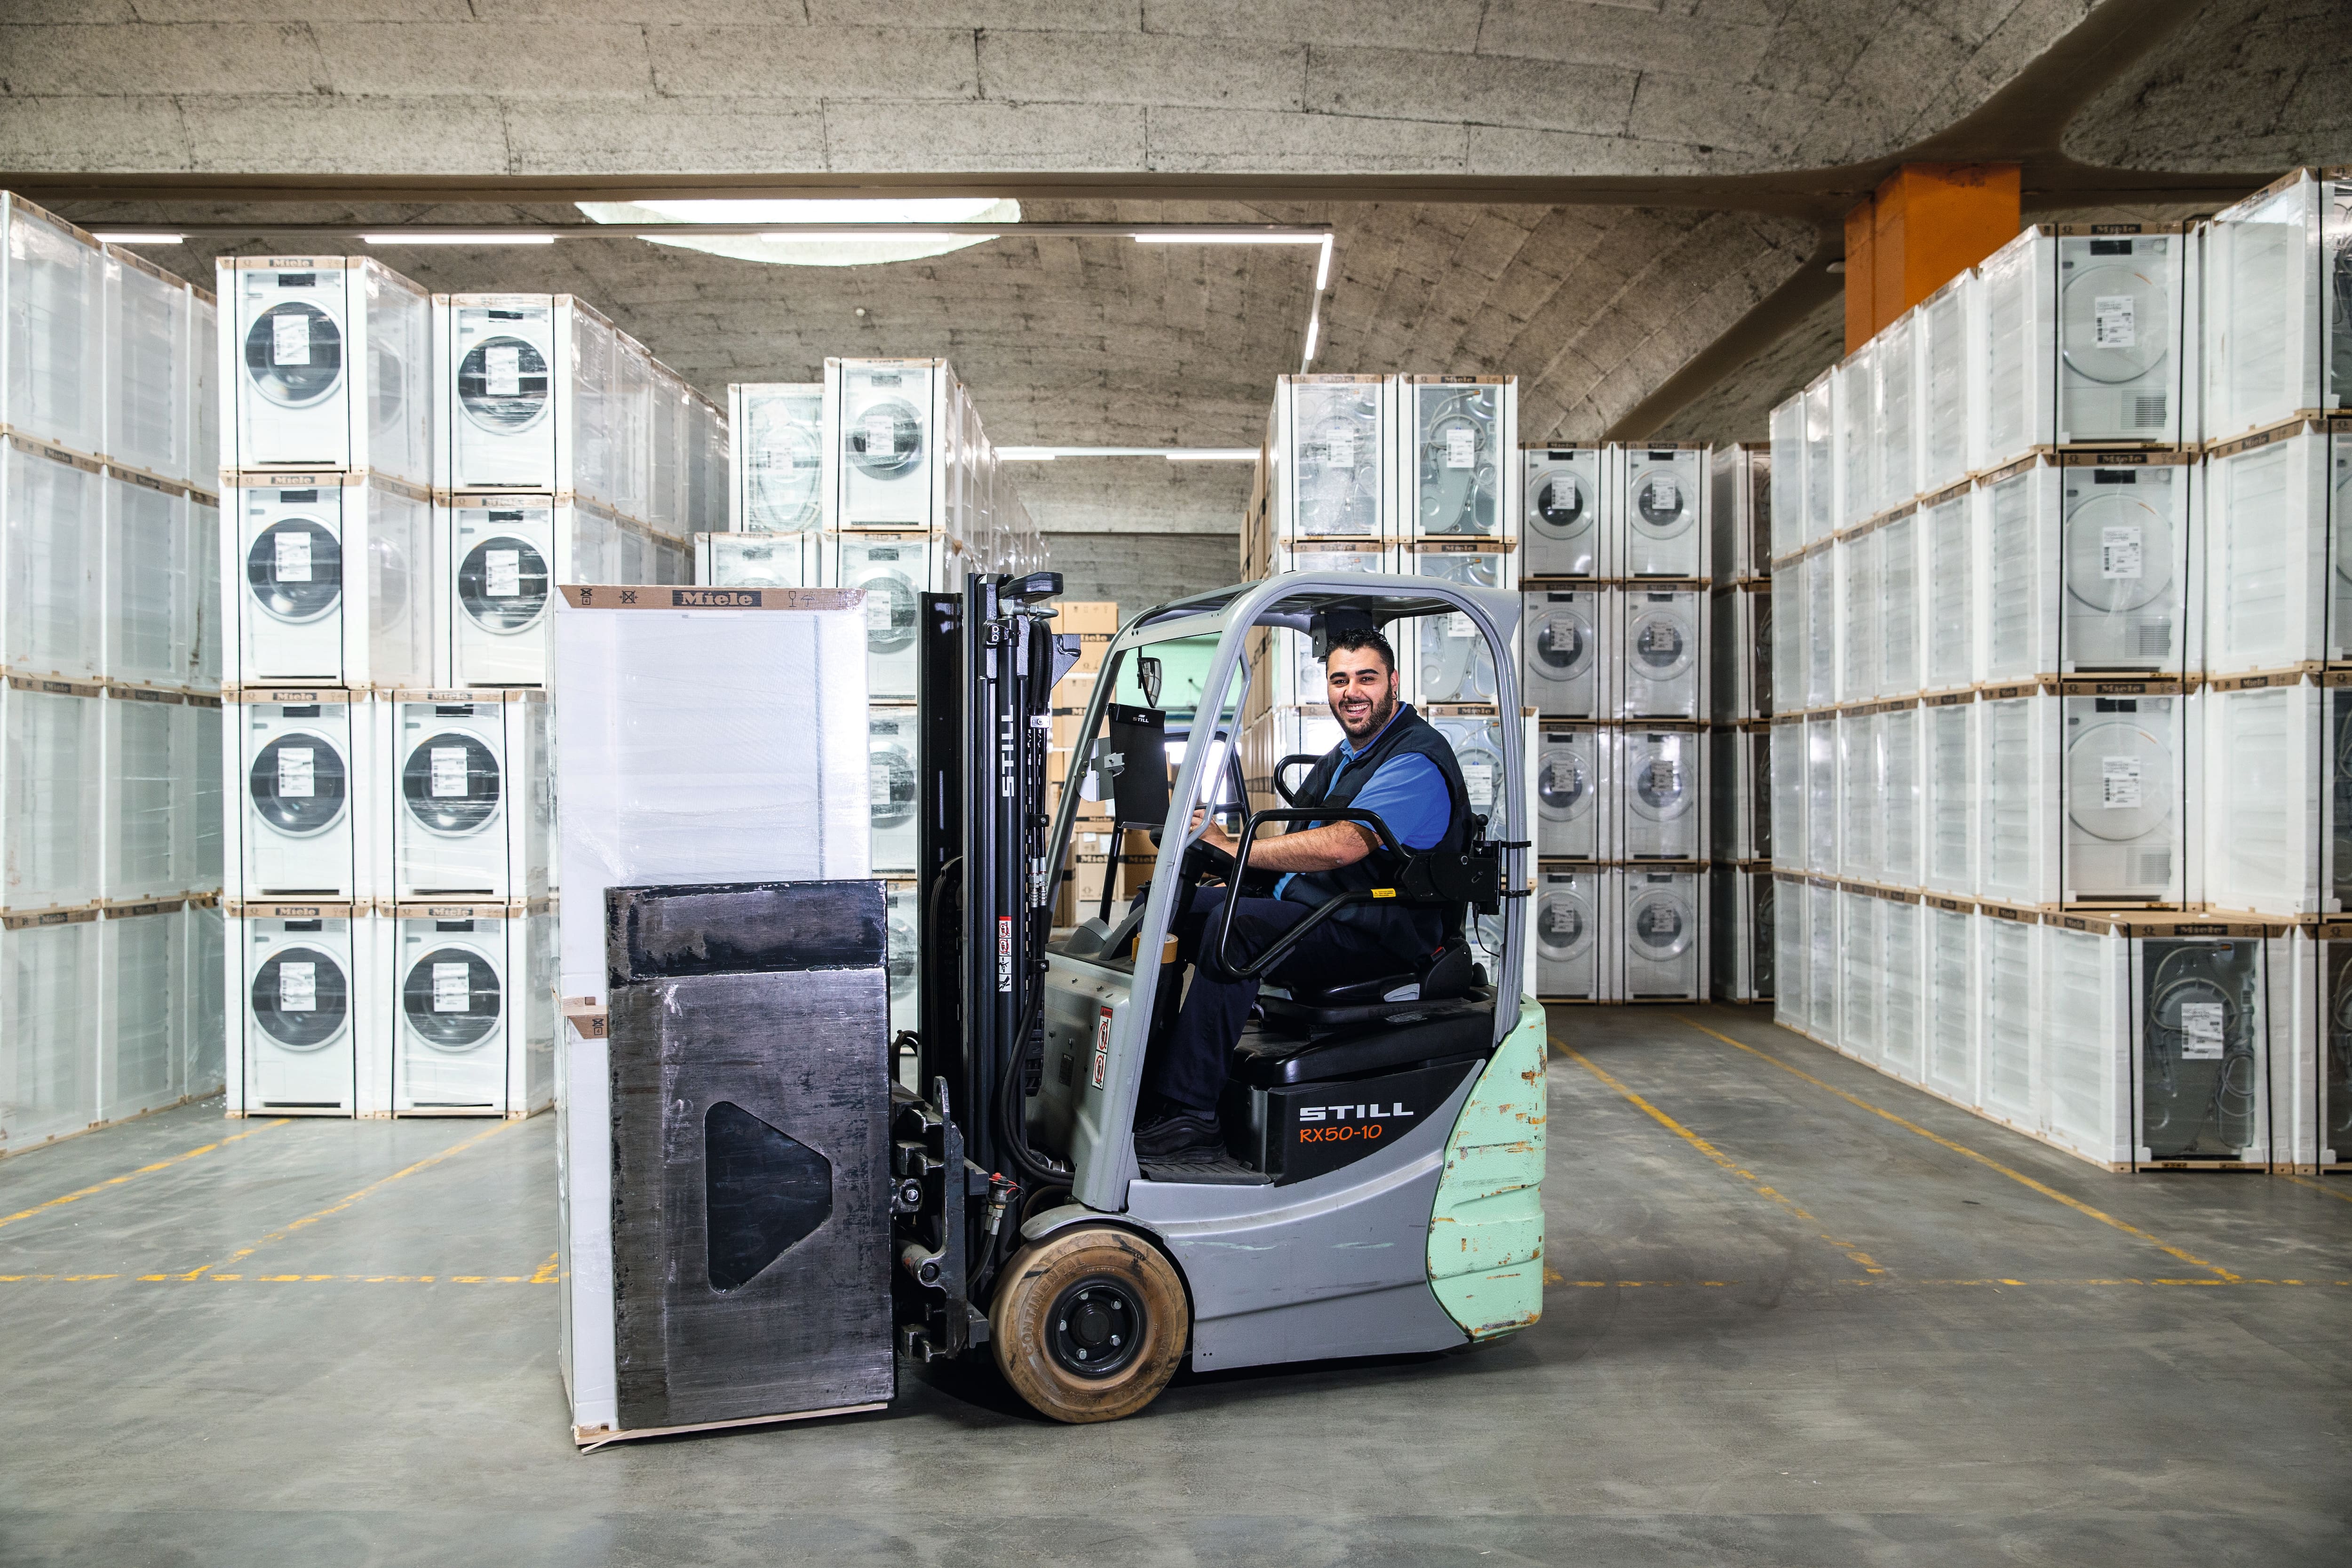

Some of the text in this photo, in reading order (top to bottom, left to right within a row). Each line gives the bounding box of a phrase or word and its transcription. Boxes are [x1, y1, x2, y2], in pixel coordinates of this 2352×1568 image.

[2097, 225, 2136, 234] Miele
[2102, 454, 2142, 463] Miele
[681, 591, 753, 606] Miele
[2243, 678, 2265, 687] Miele
[2101, 685, 2140, 693] Miele
[1001, 705, 1014, 797] STILL
[2067, 918, 2084, 929] Miele
[2180, 925, 2223, 934] Miele
[1299, 1102, 1414, 1121] STILL
[1300, 1124, 1382, 1143] RX50-10
[1021, 1257, 1085, 1355] CONTINENTAL
